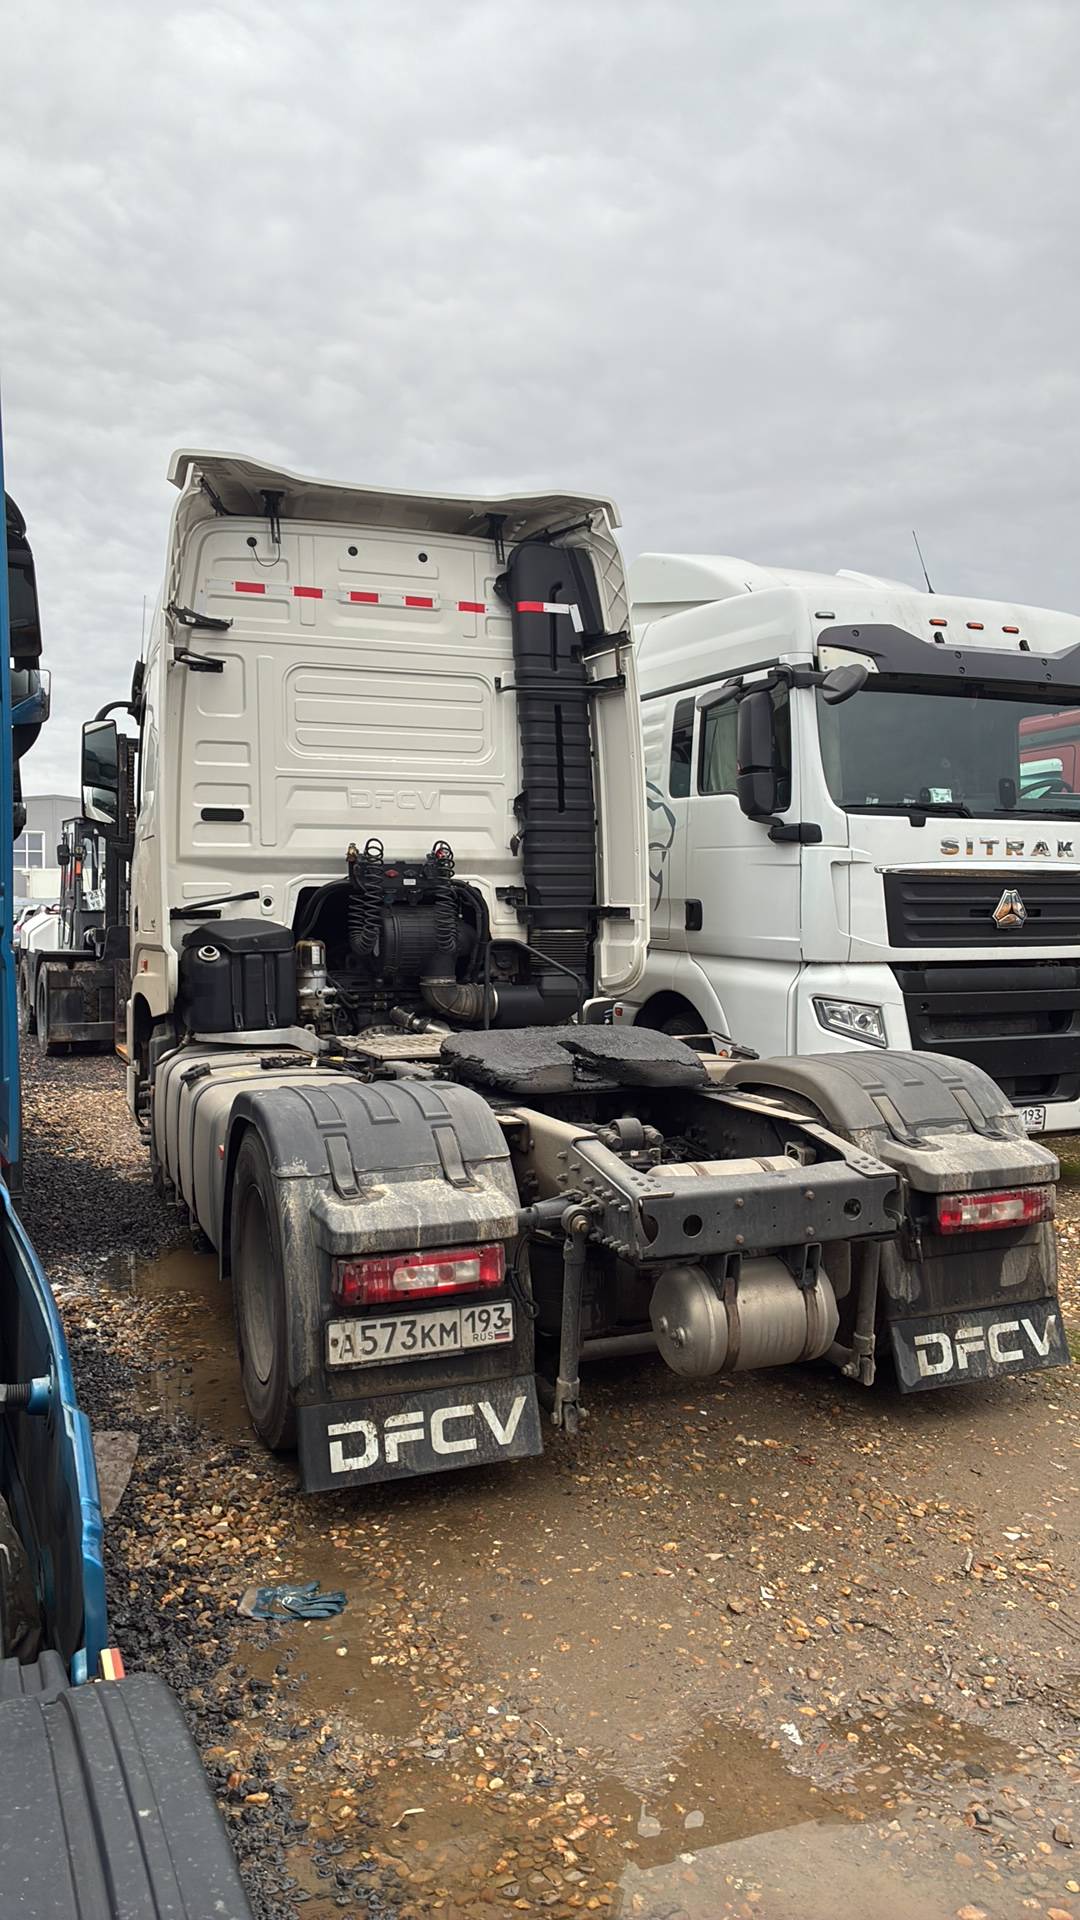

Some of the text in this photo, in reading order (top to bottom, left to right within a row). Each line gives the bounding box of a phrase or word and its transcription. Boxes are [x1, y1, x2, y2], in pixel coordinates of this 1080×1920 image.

[350, 788, 437, 810] DFCV
[940, 837, 1074, 857] SITRAK
[1022, 1109, 1042, 1120] 193
[464, 1306, 506, 1332] 193
[472, 1331, 494, 1343] RUS
[914, 1315, 1056, 1377] DFCV
[327, 1396, 527, 1474] DFCV
